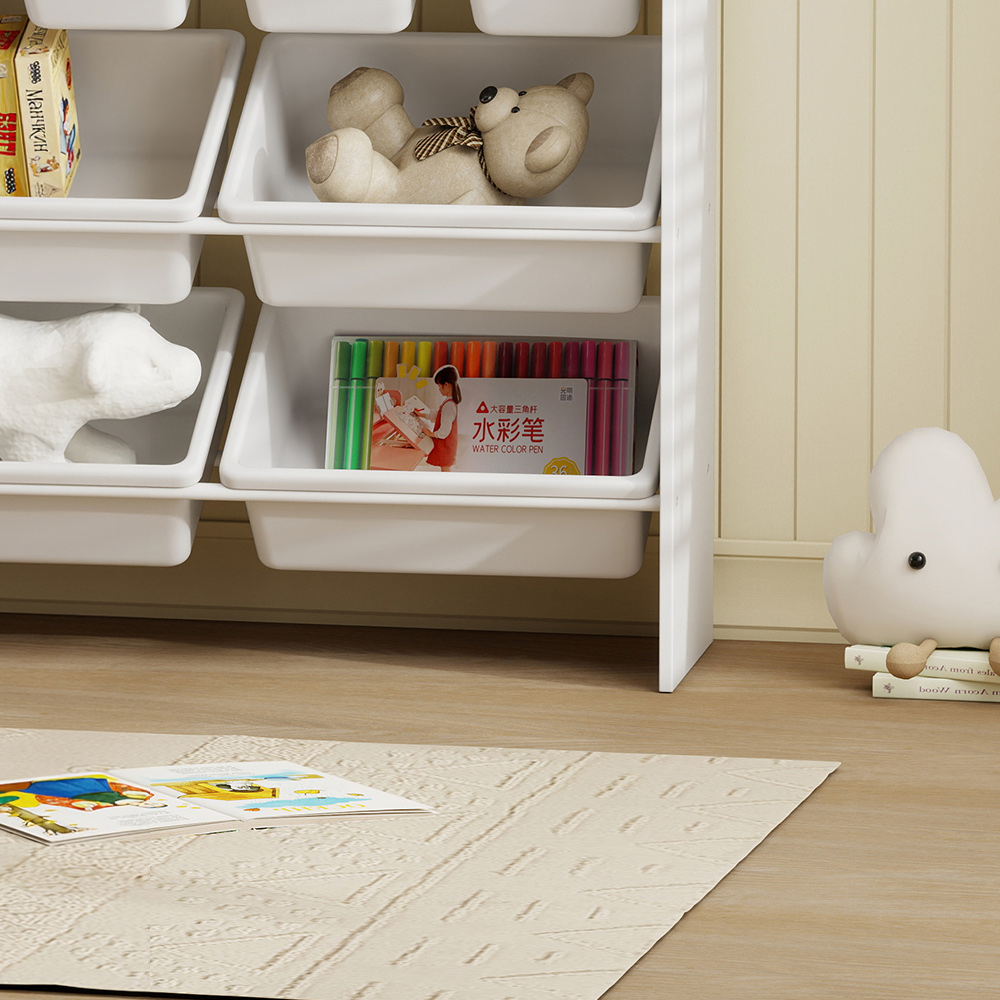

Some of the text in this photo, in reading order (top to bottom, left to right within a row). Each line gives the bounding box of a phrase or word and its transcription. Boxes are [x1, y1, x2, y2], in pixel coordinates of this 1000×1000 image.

[25, 89, 48, 153] Манчкин
[472, 417, 545, 443] 水彩笔
[472, 445, 544, 453] WATER COLOR PEN
